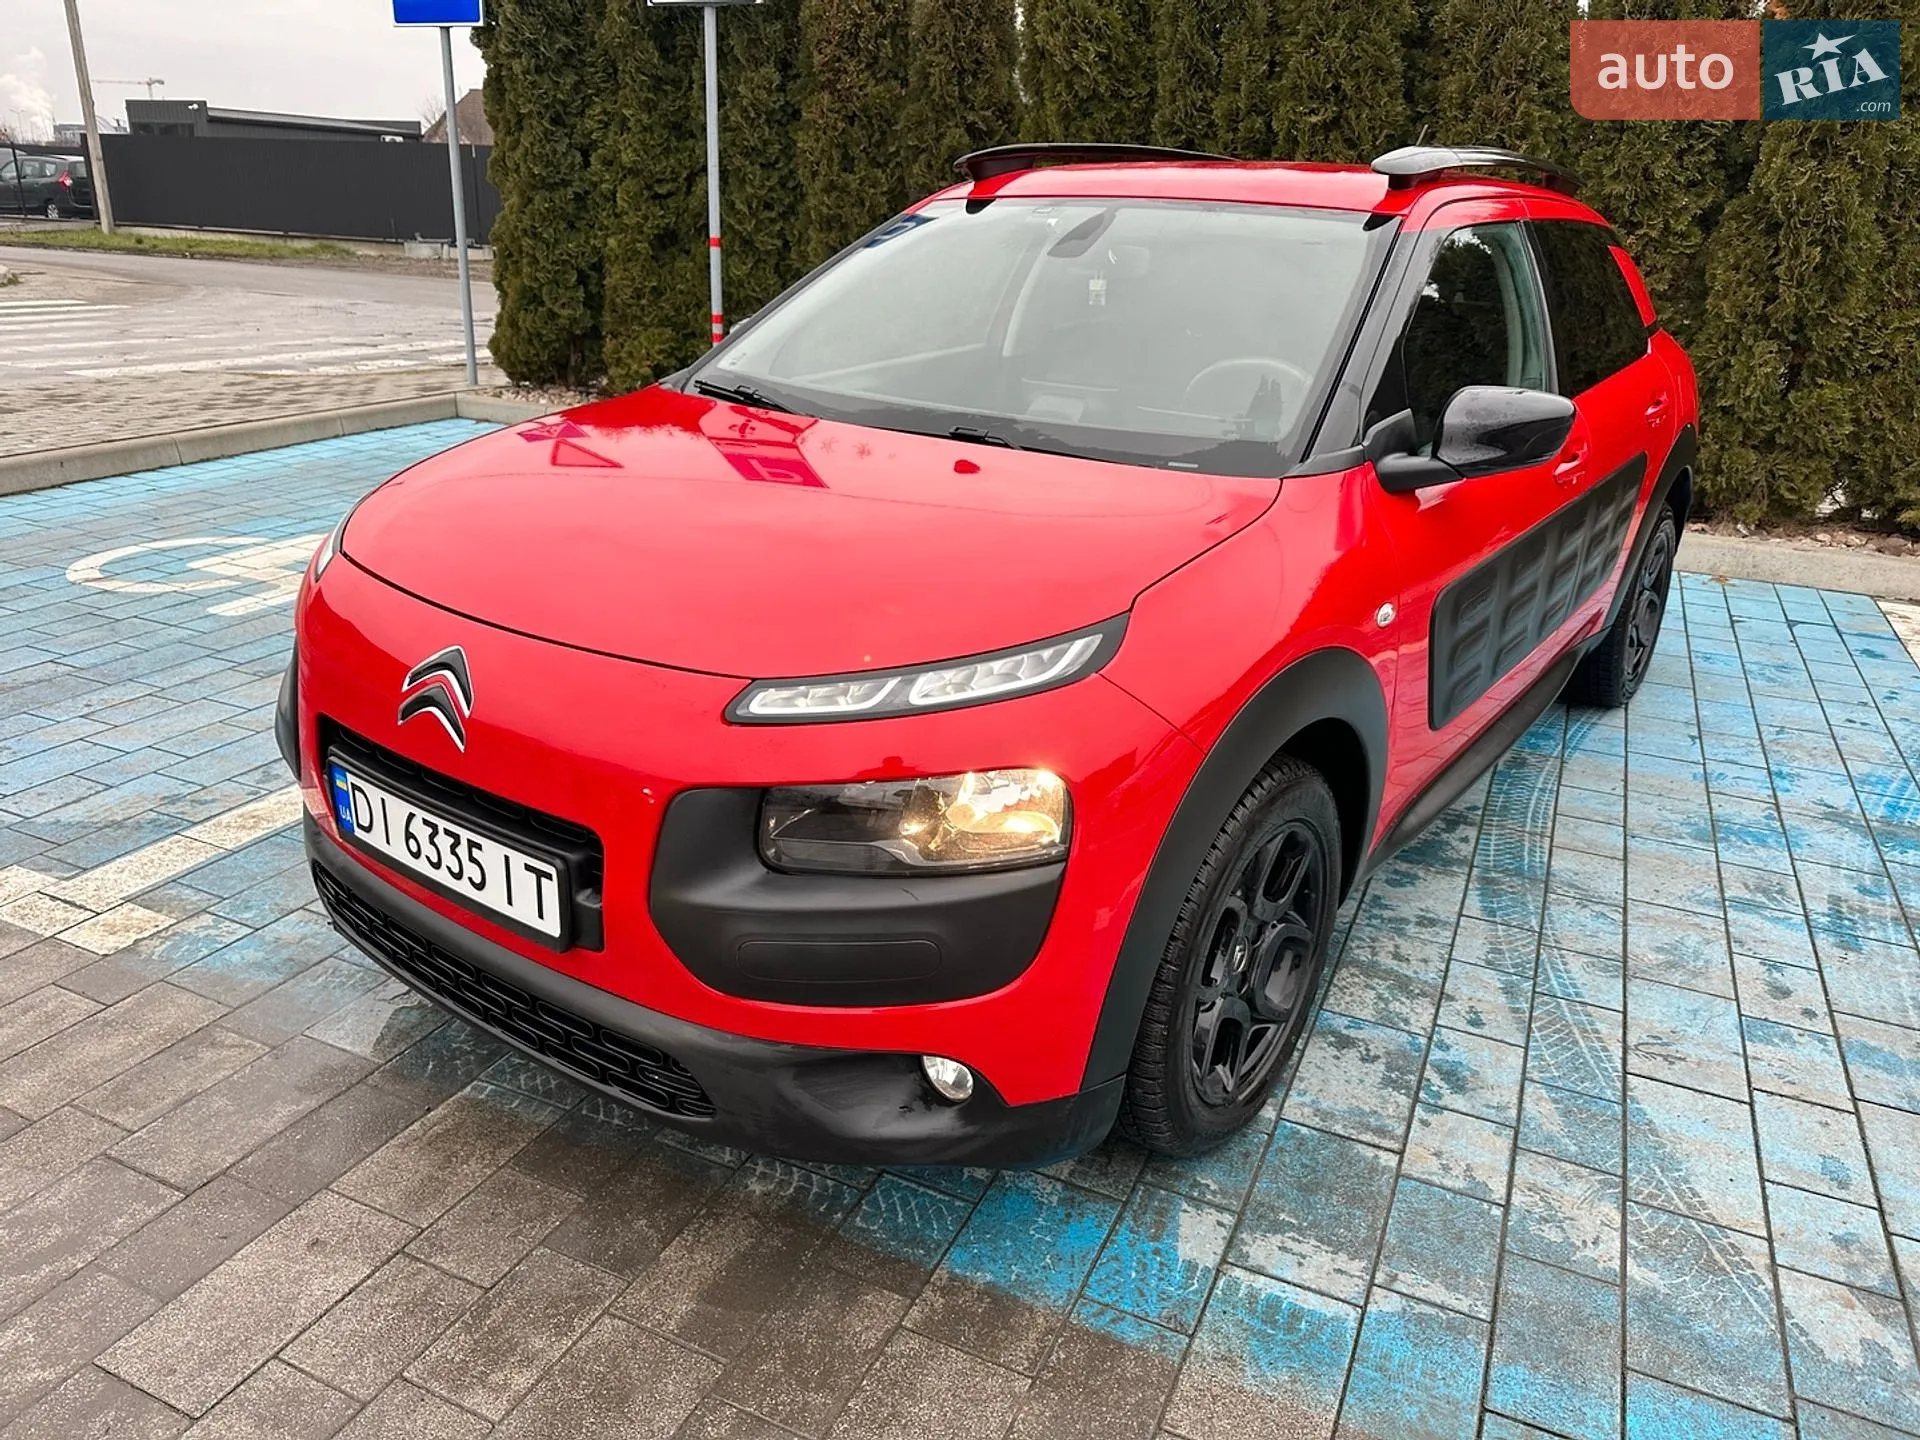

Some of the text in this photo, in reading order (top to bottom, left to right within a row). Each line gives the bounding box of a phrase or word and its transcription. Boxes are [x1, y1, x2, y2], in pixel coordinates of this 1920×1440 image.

[338, 804, 353, 824] UA
[350, 781, 553, 921] DI 6335 IT
